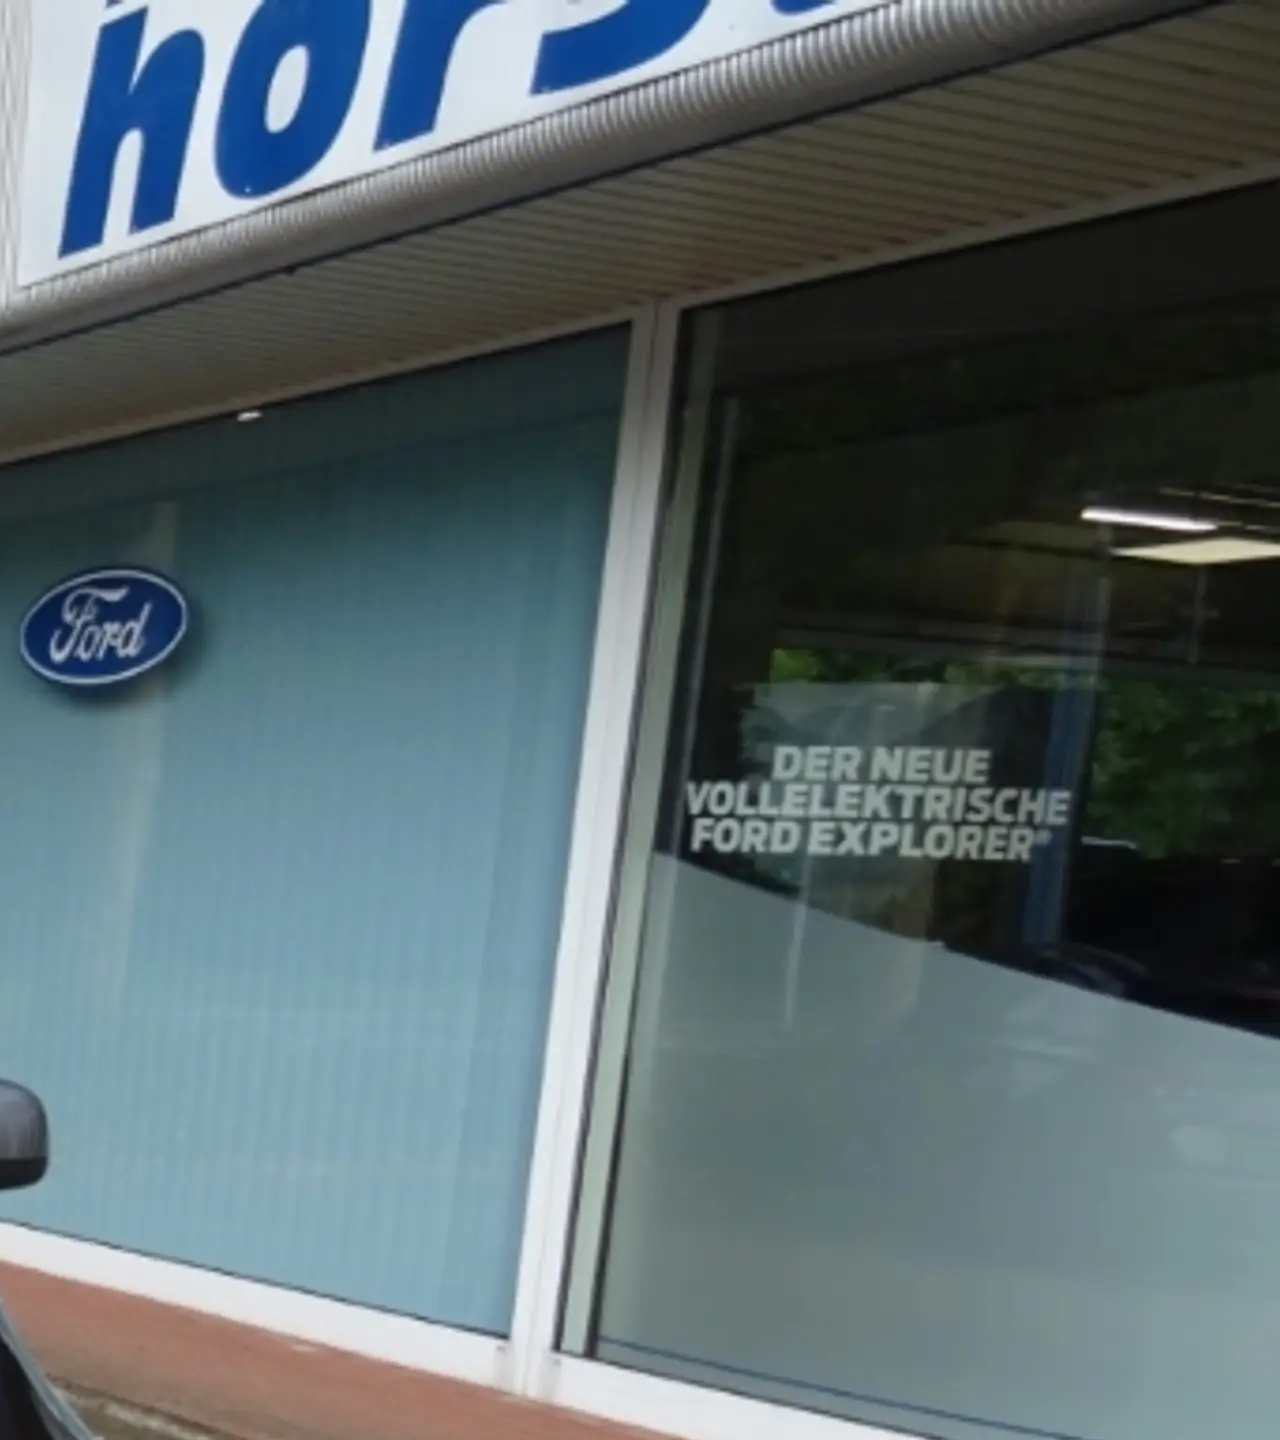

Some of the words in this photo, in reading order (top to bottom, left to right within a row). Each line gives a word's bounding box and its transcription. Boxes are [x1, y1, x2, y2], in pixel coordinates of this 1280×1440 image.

[57, 0, 837, 259] hor
[48, 584, 153, 665] Ford
[772, 745, 859, 782] DER
[868, 746, 993, 784] NEUE
[685, 780, 1073, 826] VOLLELEKTRISCHE
[690, 817, 802, 853] FORD
